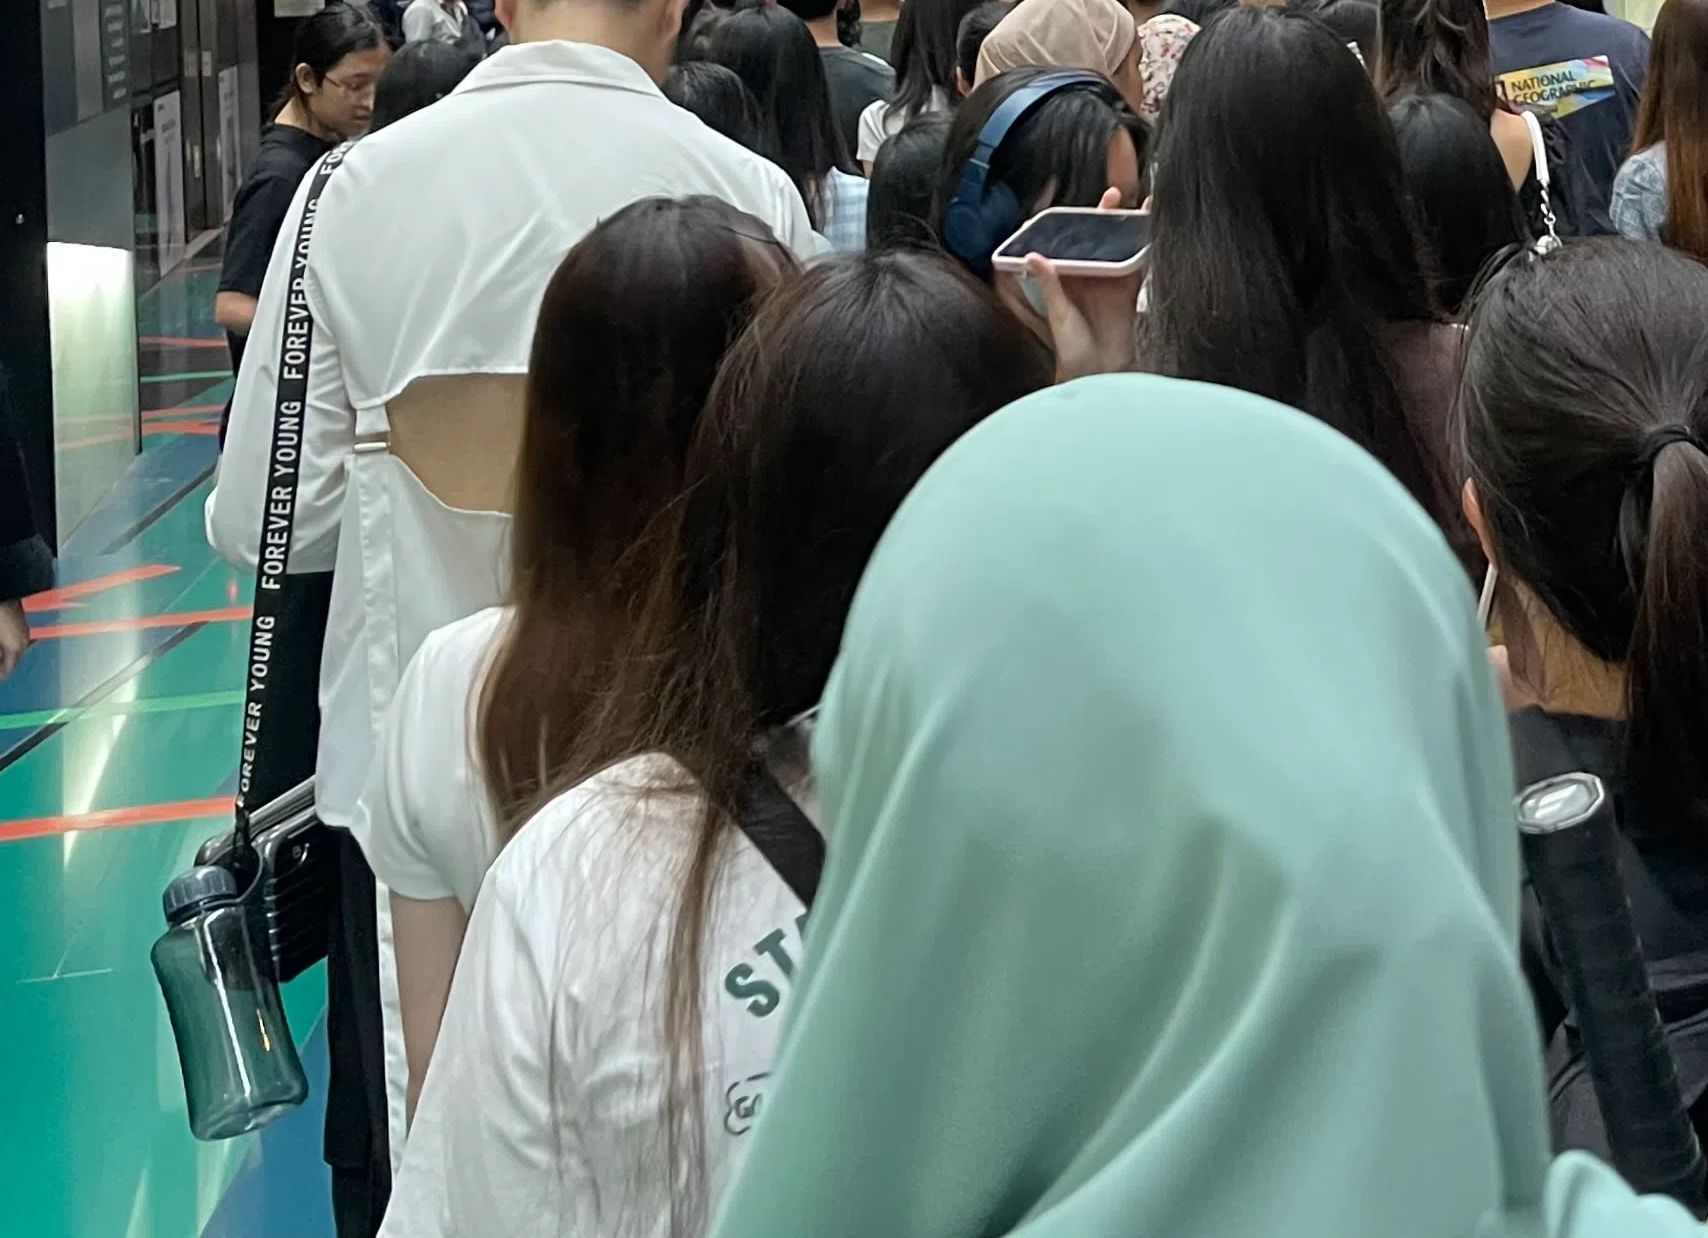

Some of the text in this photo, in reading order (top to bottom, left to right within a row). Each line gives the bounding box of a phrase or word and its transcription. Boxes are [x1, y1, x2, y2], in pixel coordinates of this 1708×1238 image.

[1511, 70, 1576, 93] NATIONAL
[262, 401, 302, 590] FOREVER YOUNG
[236, 615, 275, 808] FOREVER YOUNG
[724, 915, 810, 1018] ST
